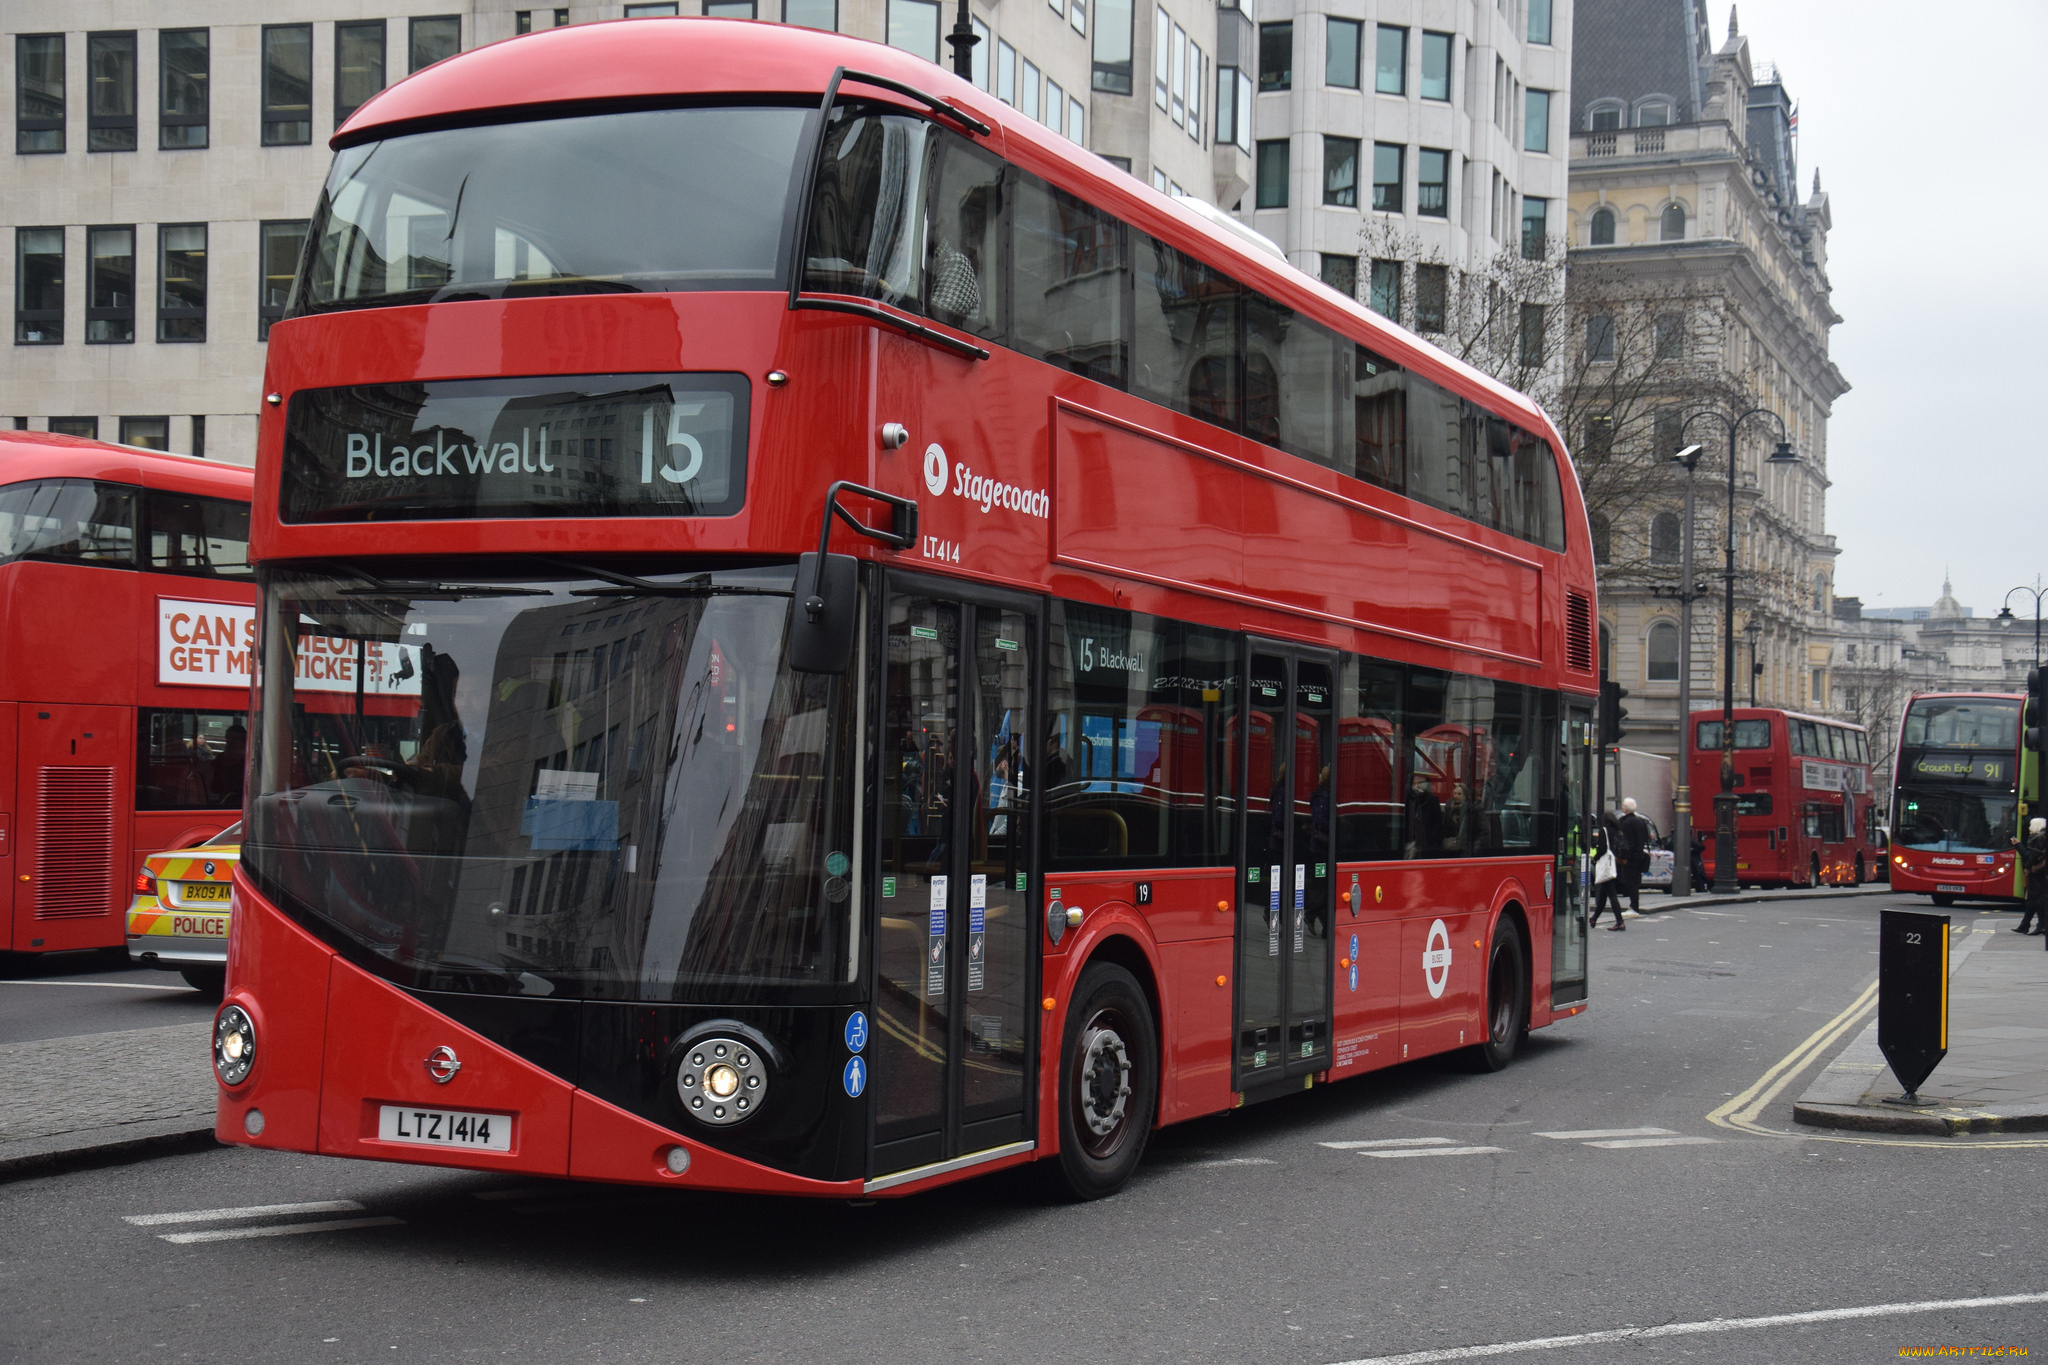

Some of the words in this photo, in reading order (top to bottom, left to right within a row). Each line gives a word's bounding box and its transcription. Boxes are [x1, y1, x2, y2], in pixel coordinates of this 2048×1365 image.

[346, 426, 554, 478] Blackwall
[641, 403, 705, 484] 15
[953, 462, 1049, 519] Stagecoach
[923, 535, 960, 563] LT414
[169, 646, 218, 673] GET
[1080, 638, 1095, 672] 15
[1100, 646, 1144, 673] Blackwall
[2015, 647, 2048, 655] VICTR
[1918, 762, 1951, 773] Crouch
[1954, 763, 1973, 774] End
[1984, 763, 1999, 778] 91
[186, 886, 215, 899] BX09
[218, 887, 231, 899] AN
[1139, 884, 1148, 902] 19
[173, 917, 224, 935] POLICE
[1906, 932, 1921, 945] 22
